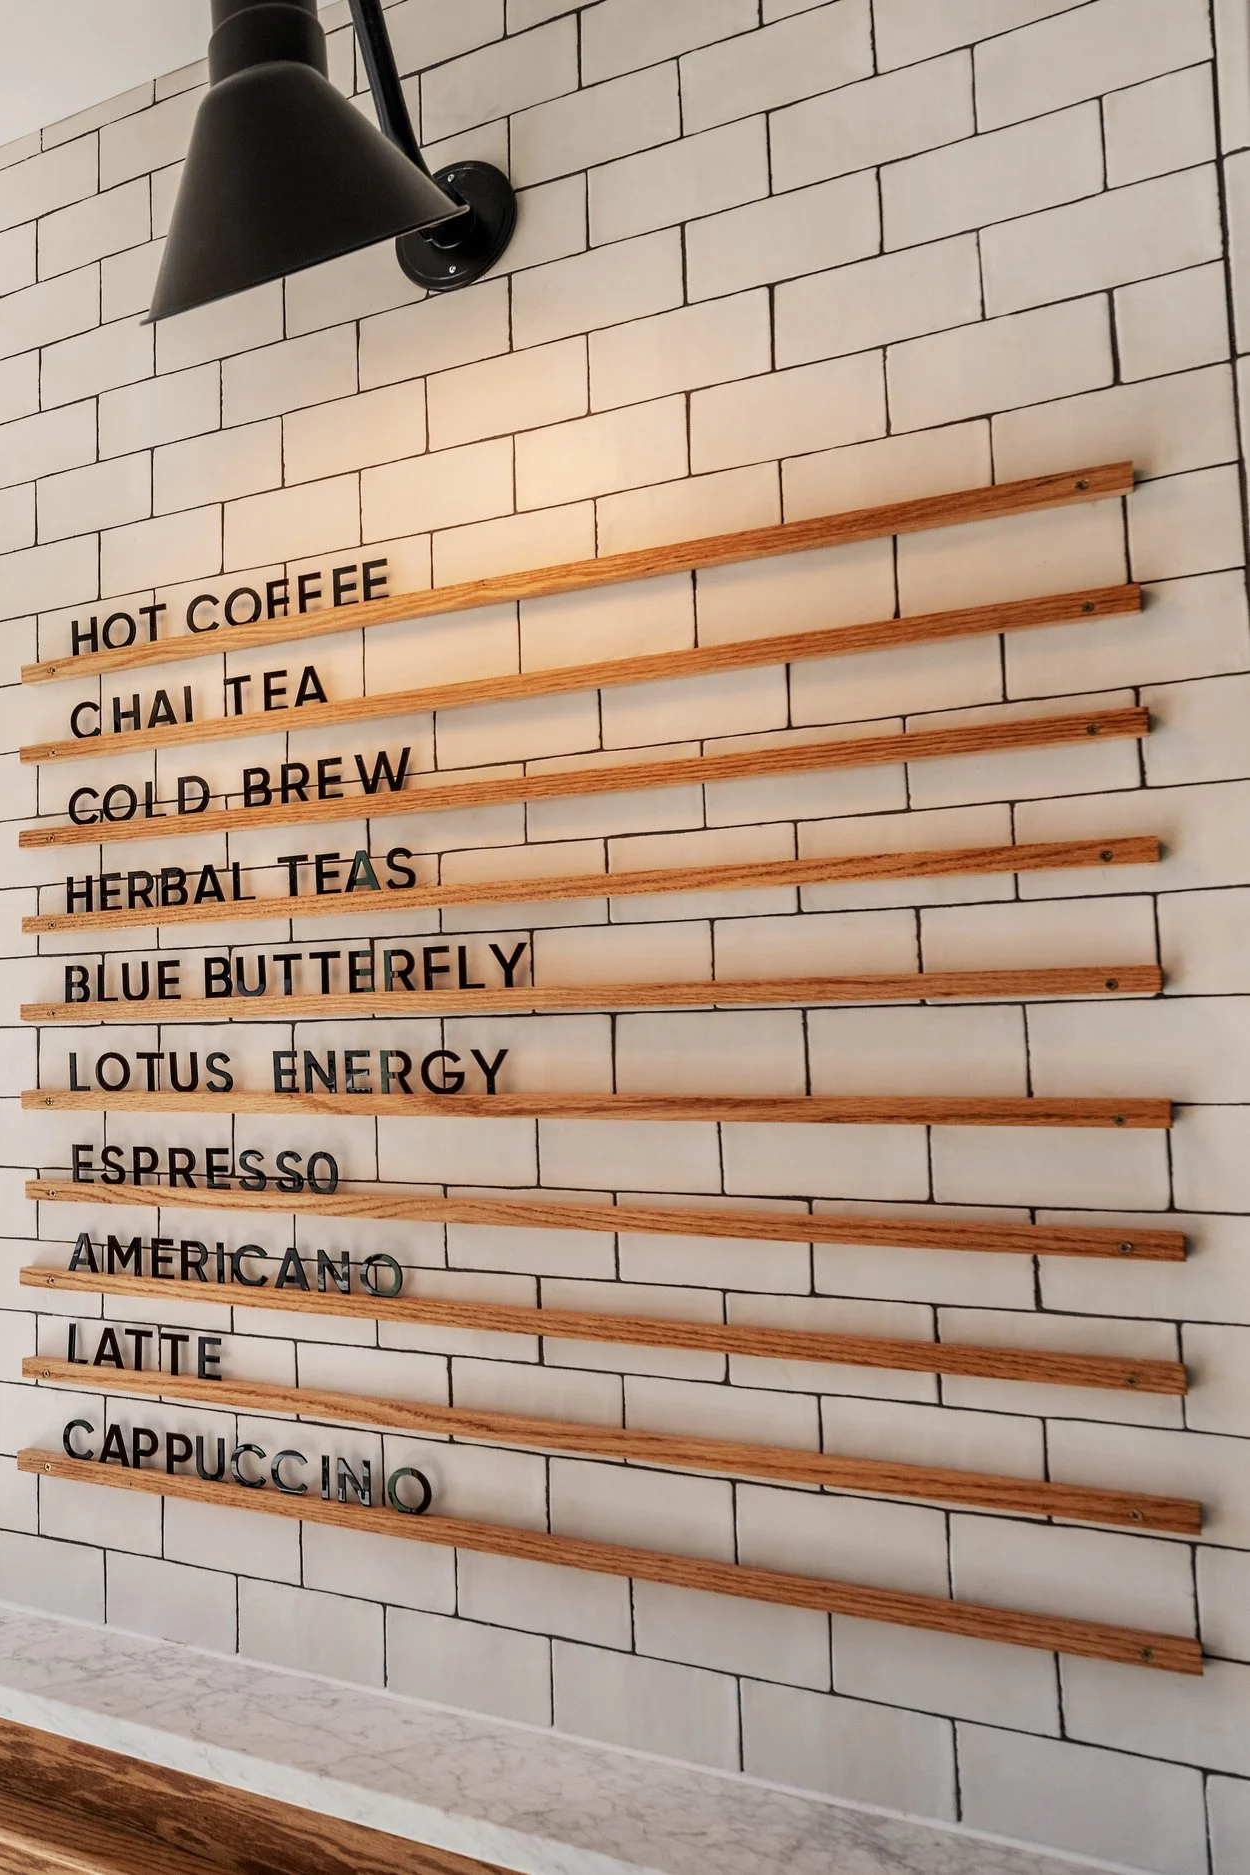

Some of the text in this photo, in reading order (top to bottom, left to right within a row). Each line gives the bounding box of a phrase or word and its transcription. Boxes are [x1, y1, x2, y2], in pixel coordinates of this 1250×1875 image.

[70, 558, 390, 656] HOT COFFEE
[69, 665, 329, 740] CHAI TEA
[68, 747, 412, 826] COLD BREW
[66, 847, 417, 915] HERBAL TEAS
[64, 942, 528, 1004] BLUE BUTTERFLY
[68, 1049, 510, 1096] LOTUS ENERGY
[71, 1143, 339, 1195] ESPRESSO
[68, 1232, 404, 1299] AMERICANO
[68, 1323, 223, 1381] LATTE
[62, 1418, 433, 1516] CAPPUCCINO
